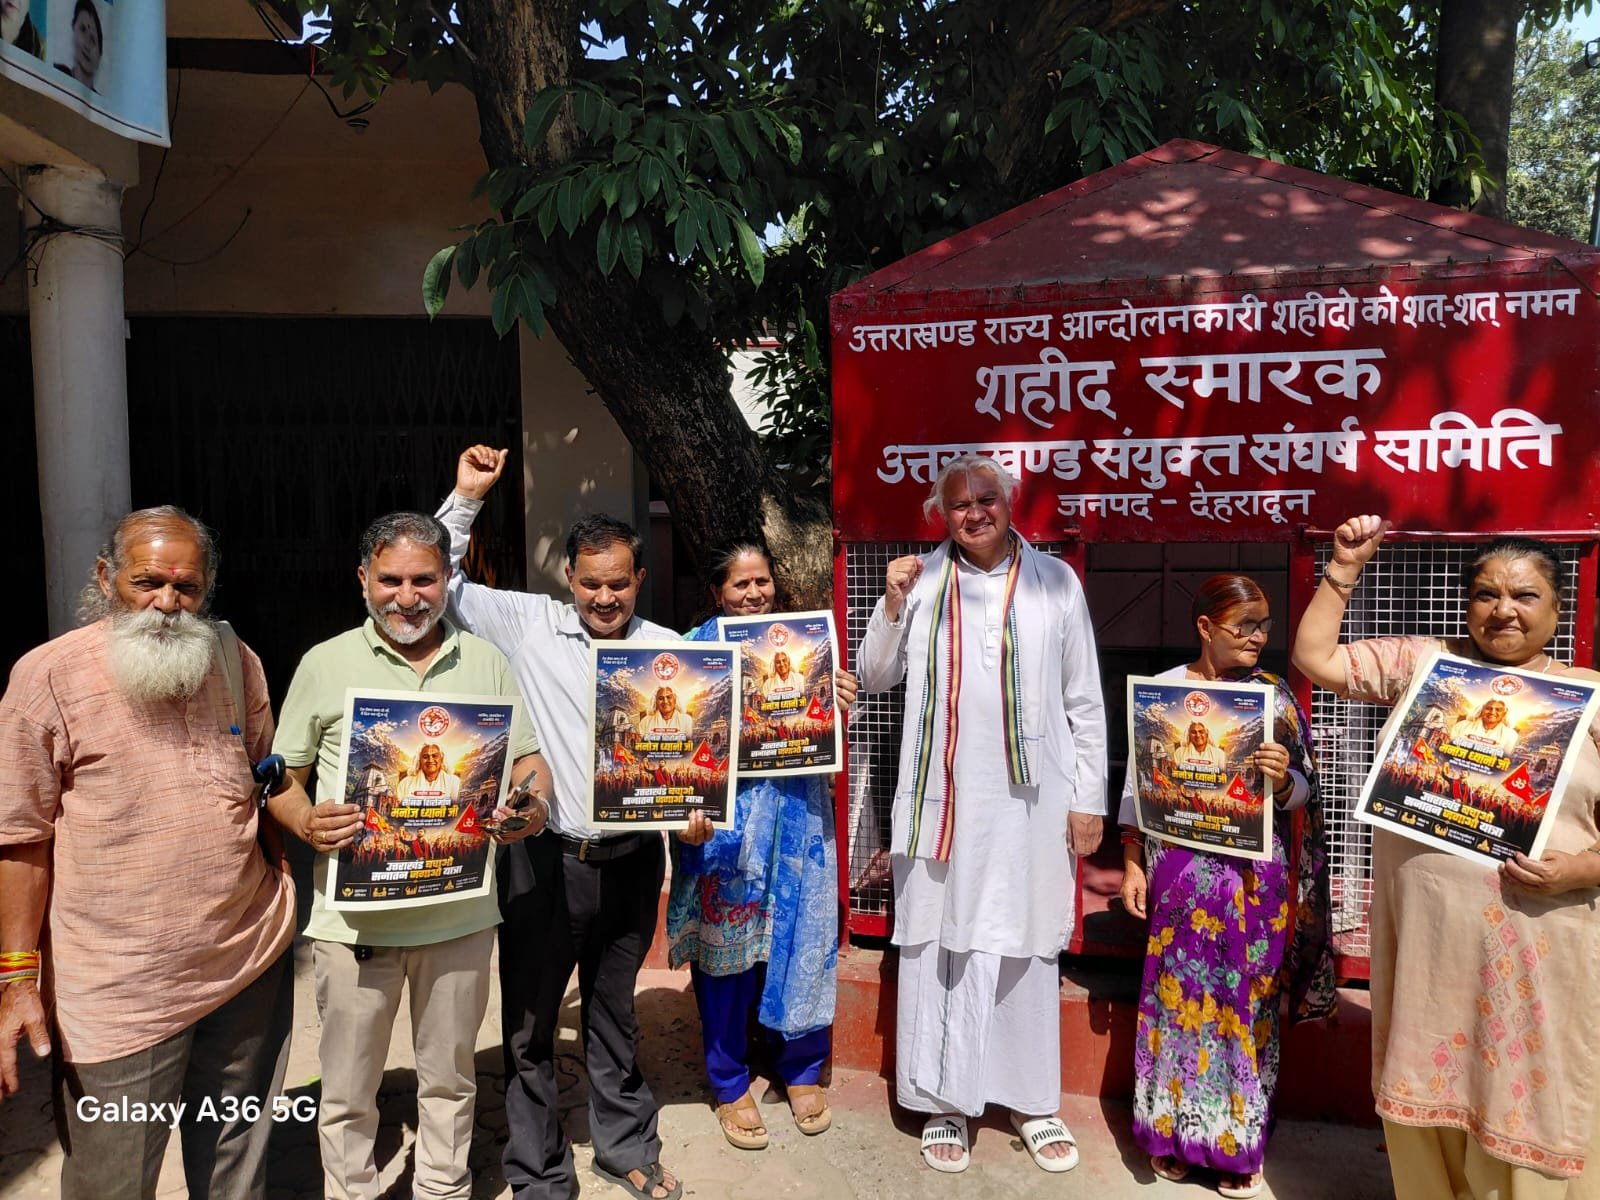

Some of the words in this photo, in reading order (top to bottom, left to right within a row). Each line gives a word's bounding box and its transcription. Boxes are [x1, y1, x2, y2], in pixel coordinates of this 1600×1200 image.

[849, 319, 978, 352] उत्तराखण्ड
[984, 314, 1054, 345] राज्य
[1060, 293, 1268, 342] आन्दोलनकारी
[1271, 287, 1360, 337] शहीदो
[1362, 284, 1400, 326] को
[1504, 288, 1582, 319] नमन
[975, 346, 1117, 429] शहीद
[1139, 348, 1387, 410] स्मारक
[876, 439, 1087, 484] उत्तखण्ड
[1091, 426, 1247, 490] संयुक्त
[1249, 415, 1367, 476] संघर्ष
[1373, 408, 1563, 474] समिति
[1057, 493, 1154, 522] जनपद
[1189, 481, 1316, 524] देहरादून
